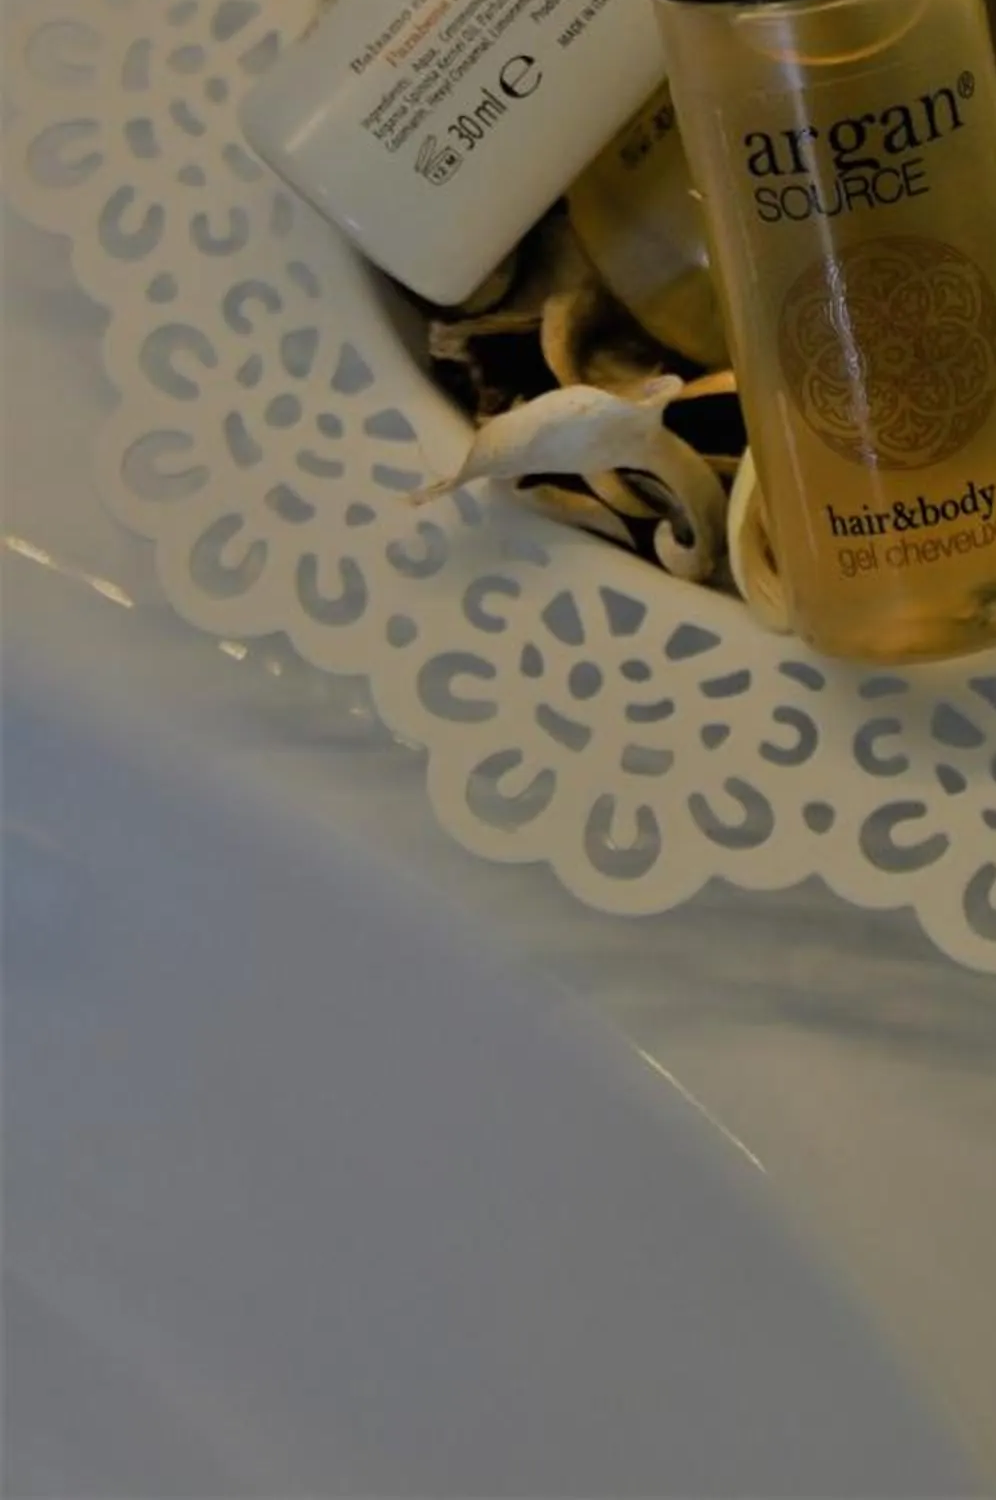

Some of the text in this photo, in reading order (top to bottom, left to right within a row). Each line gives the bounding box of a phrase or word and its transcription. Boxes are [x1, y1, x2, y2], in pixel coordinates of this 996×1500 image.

[754, 157, 930, 222] SOURCE
[826, 481, 996, 537] hair&body
[838, 542, 879, 577] gel
